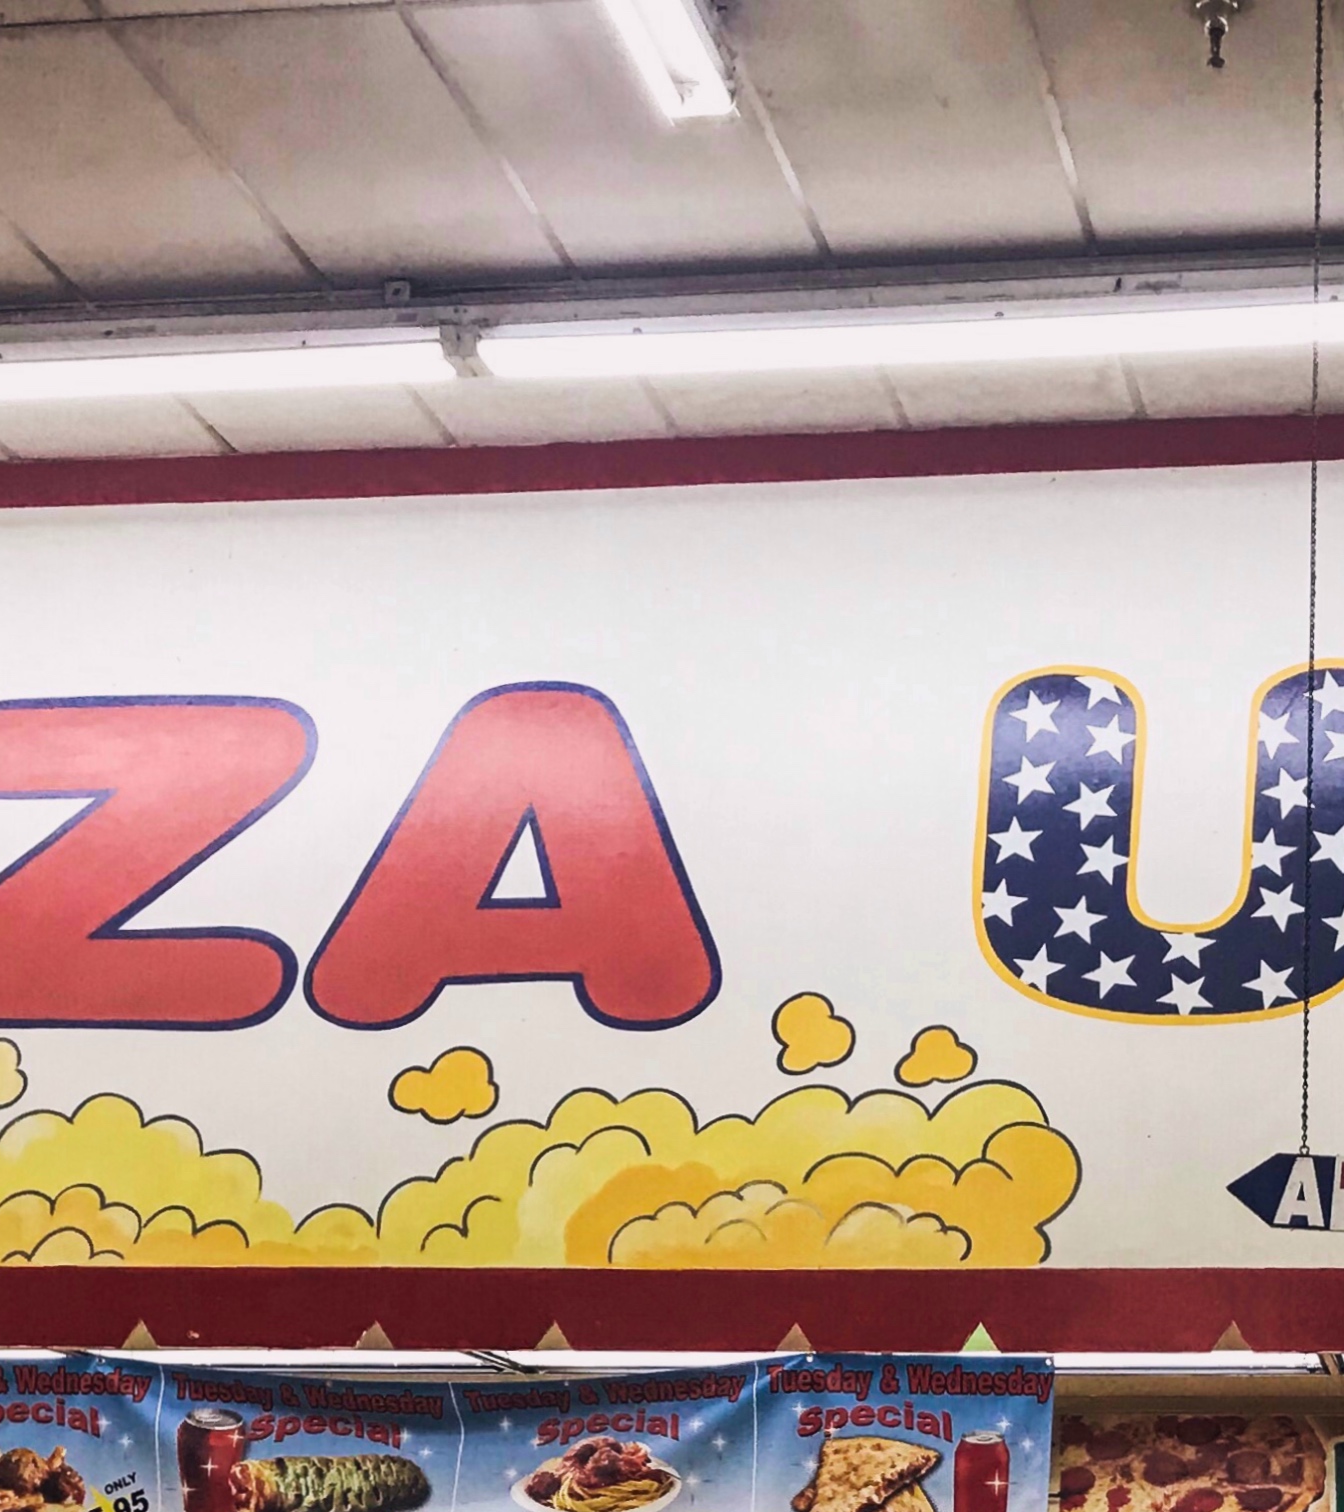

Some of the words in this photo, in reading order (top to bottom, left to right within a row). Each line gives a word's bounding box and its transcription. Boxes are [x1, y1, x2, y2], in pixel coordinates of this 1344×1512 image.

[1273, 1157, 1325, 1227] A
[14, 1364, 152, 1402] Wednesday
[172, 1372, 273, 1411] Tuesday
[279, 1384, 299, 1407] &
[303, 1384, 444, 1420] Wednesday
[464, 1389, 570, 1413] Tuesday
[578, 1384, 599, 1405] &
[602, 1372, 746, 1404] Wednesday
[767, 1362, 872, 1401] Tuesday
[880, 1364, 899, 1394] &
[907, 1363, 1055, 1404] Wednesday
[104, 1472, 138, 1496] ONLY
